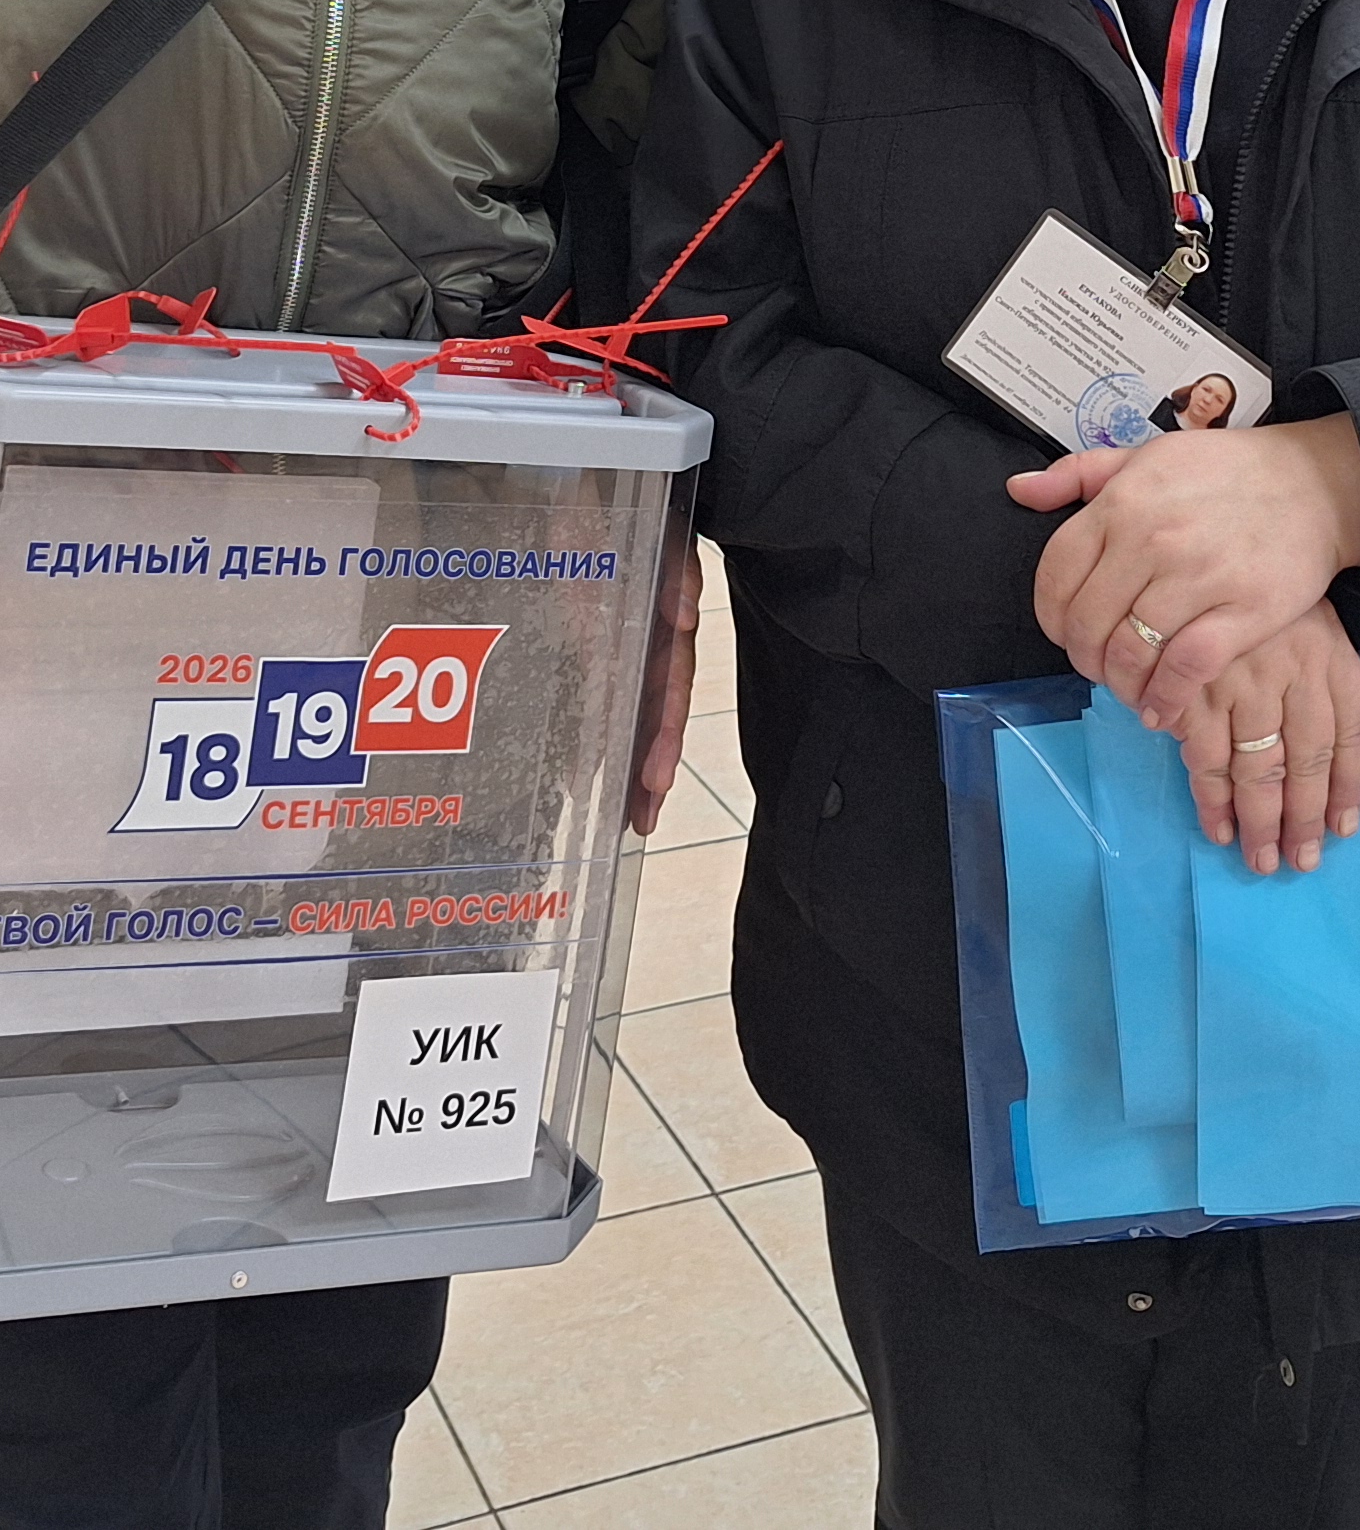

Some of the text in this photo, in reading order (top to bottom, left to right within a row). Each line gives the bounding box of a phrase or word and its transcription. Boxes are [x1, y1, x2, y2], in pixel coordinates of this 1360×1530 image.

[1078, 284, 1123, 319] ЕРГАКОВА
[1108, 286, 1189, 350] УДОСТОВЕРЕНИЕ
[25, 537, 617, 581] ЕДИНЫЙ ДЕНЬ ГОЛОСОВАНИЯ
[156, 653, 254, 684] 2026
[158, 655, 469, 802] 18 19 20
[261, 795, 463, 830] СЕНТЯБРЯ
[104, 905, 243, 943] ГОЛОС
[288, 897, 395, 935] СИЛА
[405, 891, 569, 929] РОССИИ!
[409, 1022, 503, 1066] УИК
[372, 1087, 517, 1137] № 925
